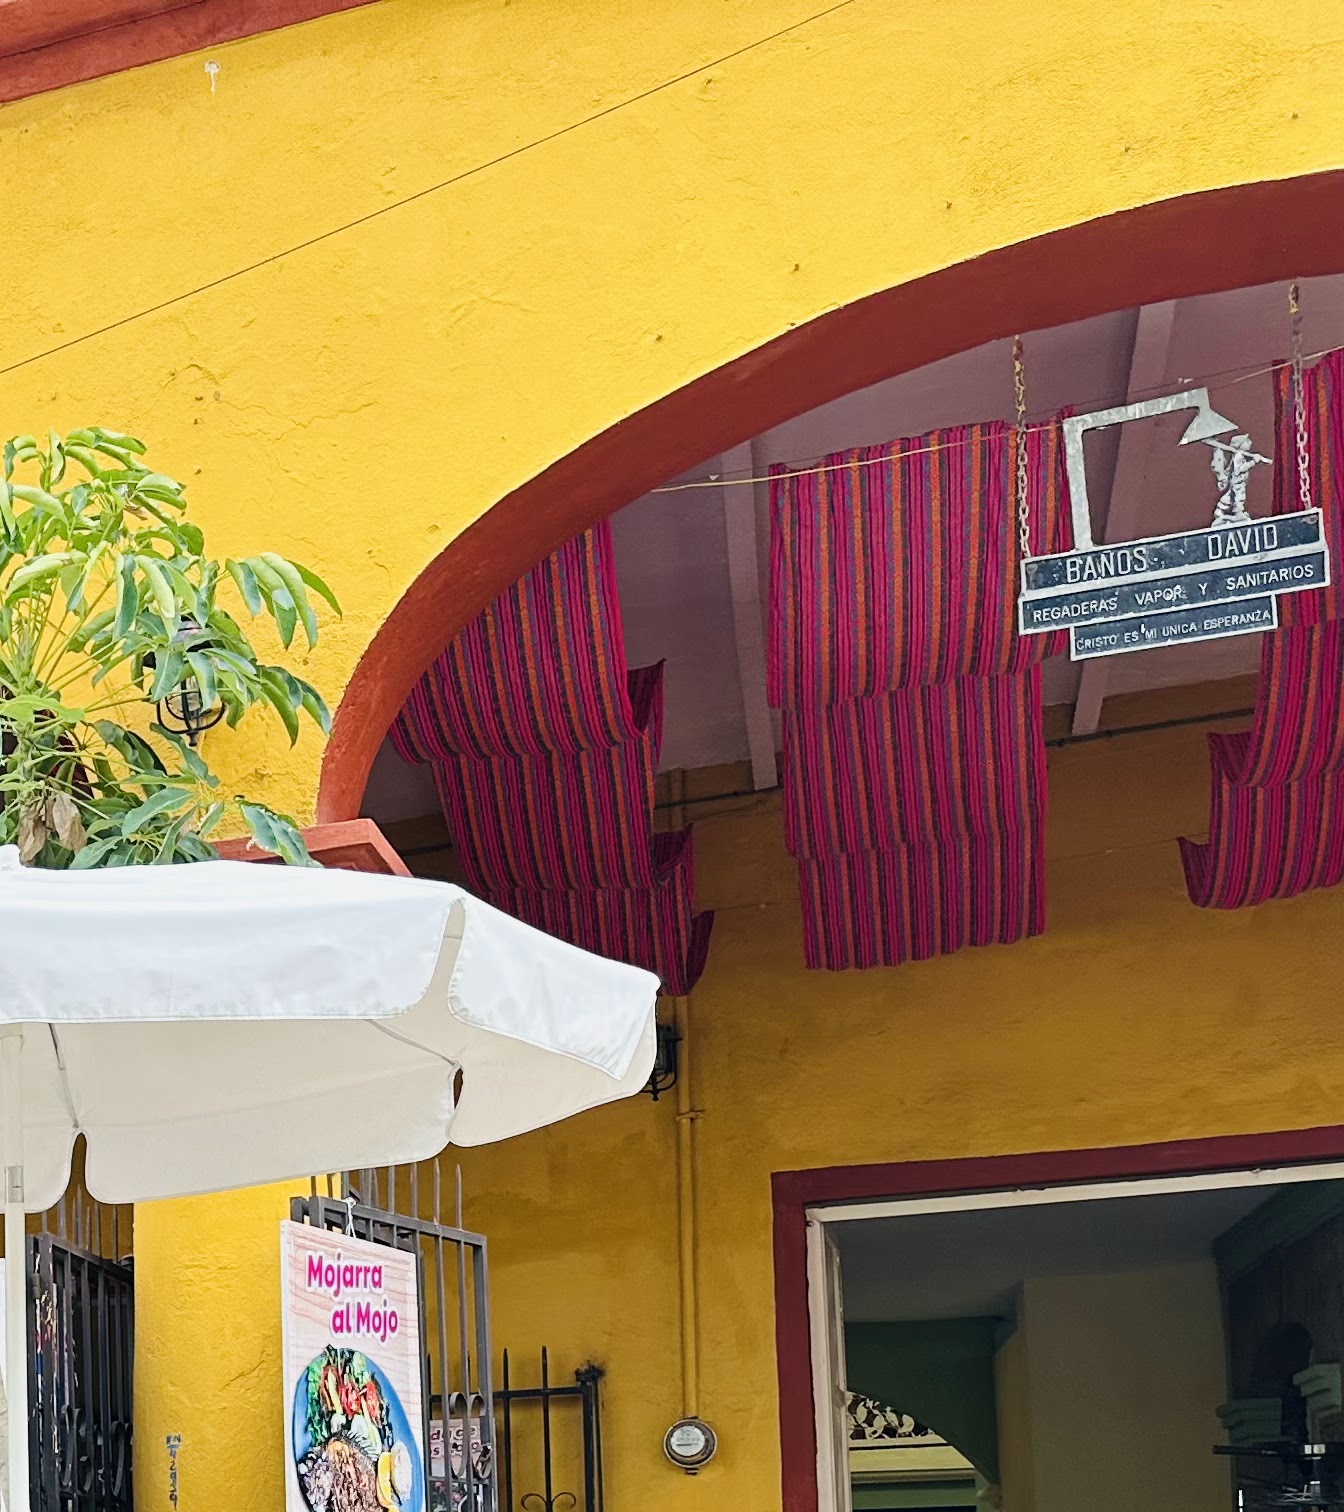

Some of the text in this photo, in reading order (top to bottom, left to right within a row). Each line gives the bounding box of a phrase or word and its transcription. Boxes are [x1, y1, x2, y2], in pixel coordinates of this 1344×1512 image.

[1207, 524, 1279, 560] DAVID
[1032, 565, 1315, 623] REGADERAS VAPOR Y SANITARIOS
[1075, 635, 1118, 651] CRISTO
[1123, 629, 1140, 643] ES
[1144, 626, 1158, 640] MI
[1202, 609, 1272, 630] ESPERANZA
[307, 1252, 383, 1298] Mojarra
[332, 1298, 398, 1342] al Mojo
